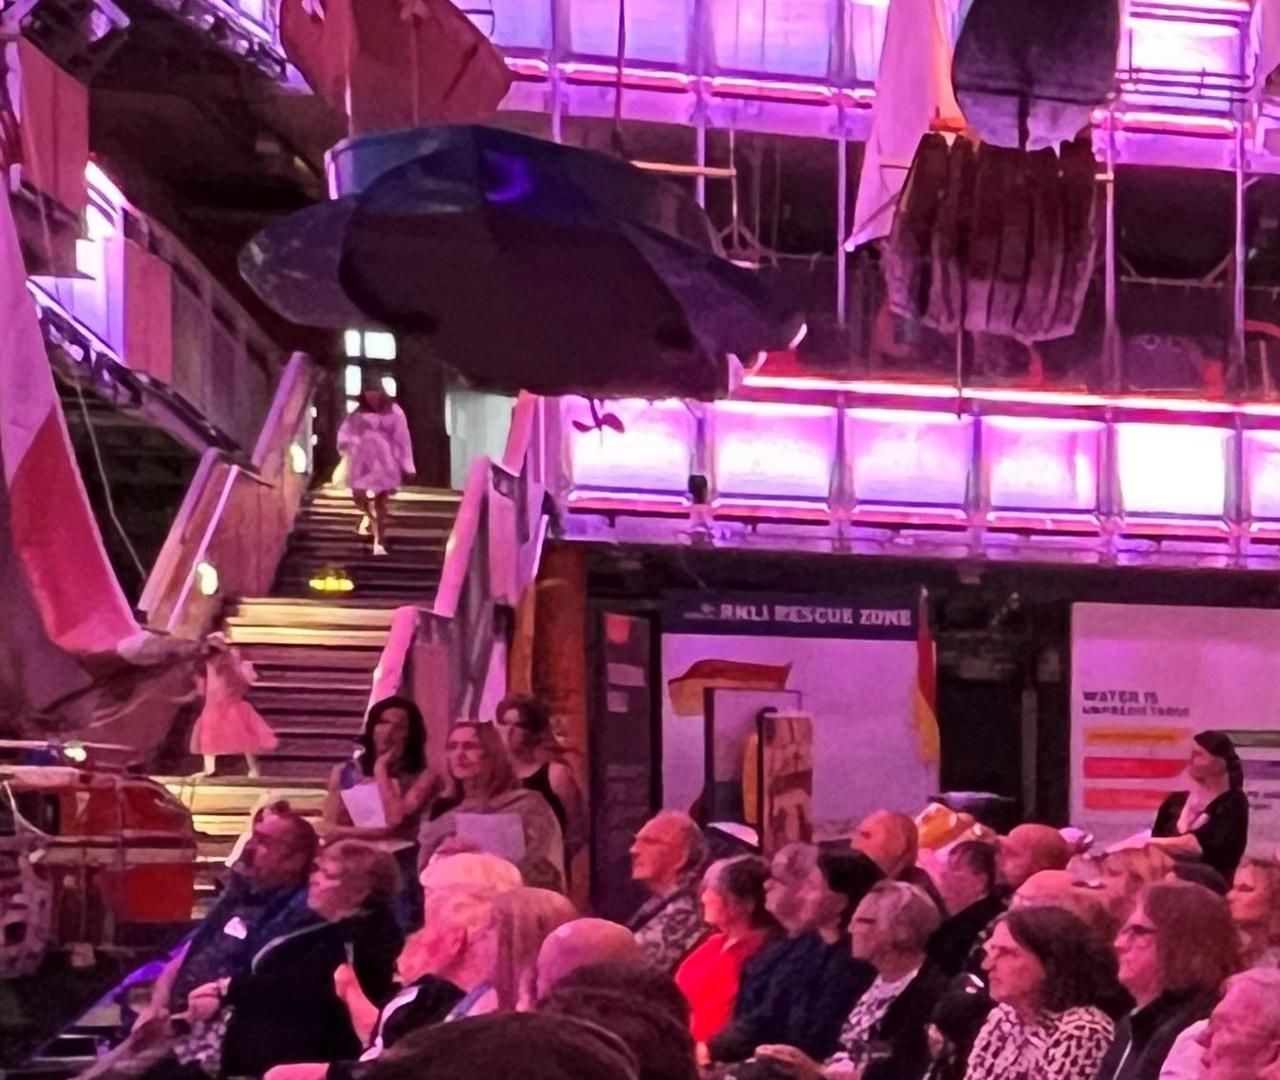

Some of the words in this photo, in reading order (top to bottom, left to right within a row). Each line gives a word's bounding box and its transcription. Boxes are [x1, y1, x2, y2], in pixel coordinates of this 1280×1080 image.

[774, 605, 853, 624] RESCUE
[860, 608, 912, 626] ZONE
[1082, 689, 1139, 705] WATER
